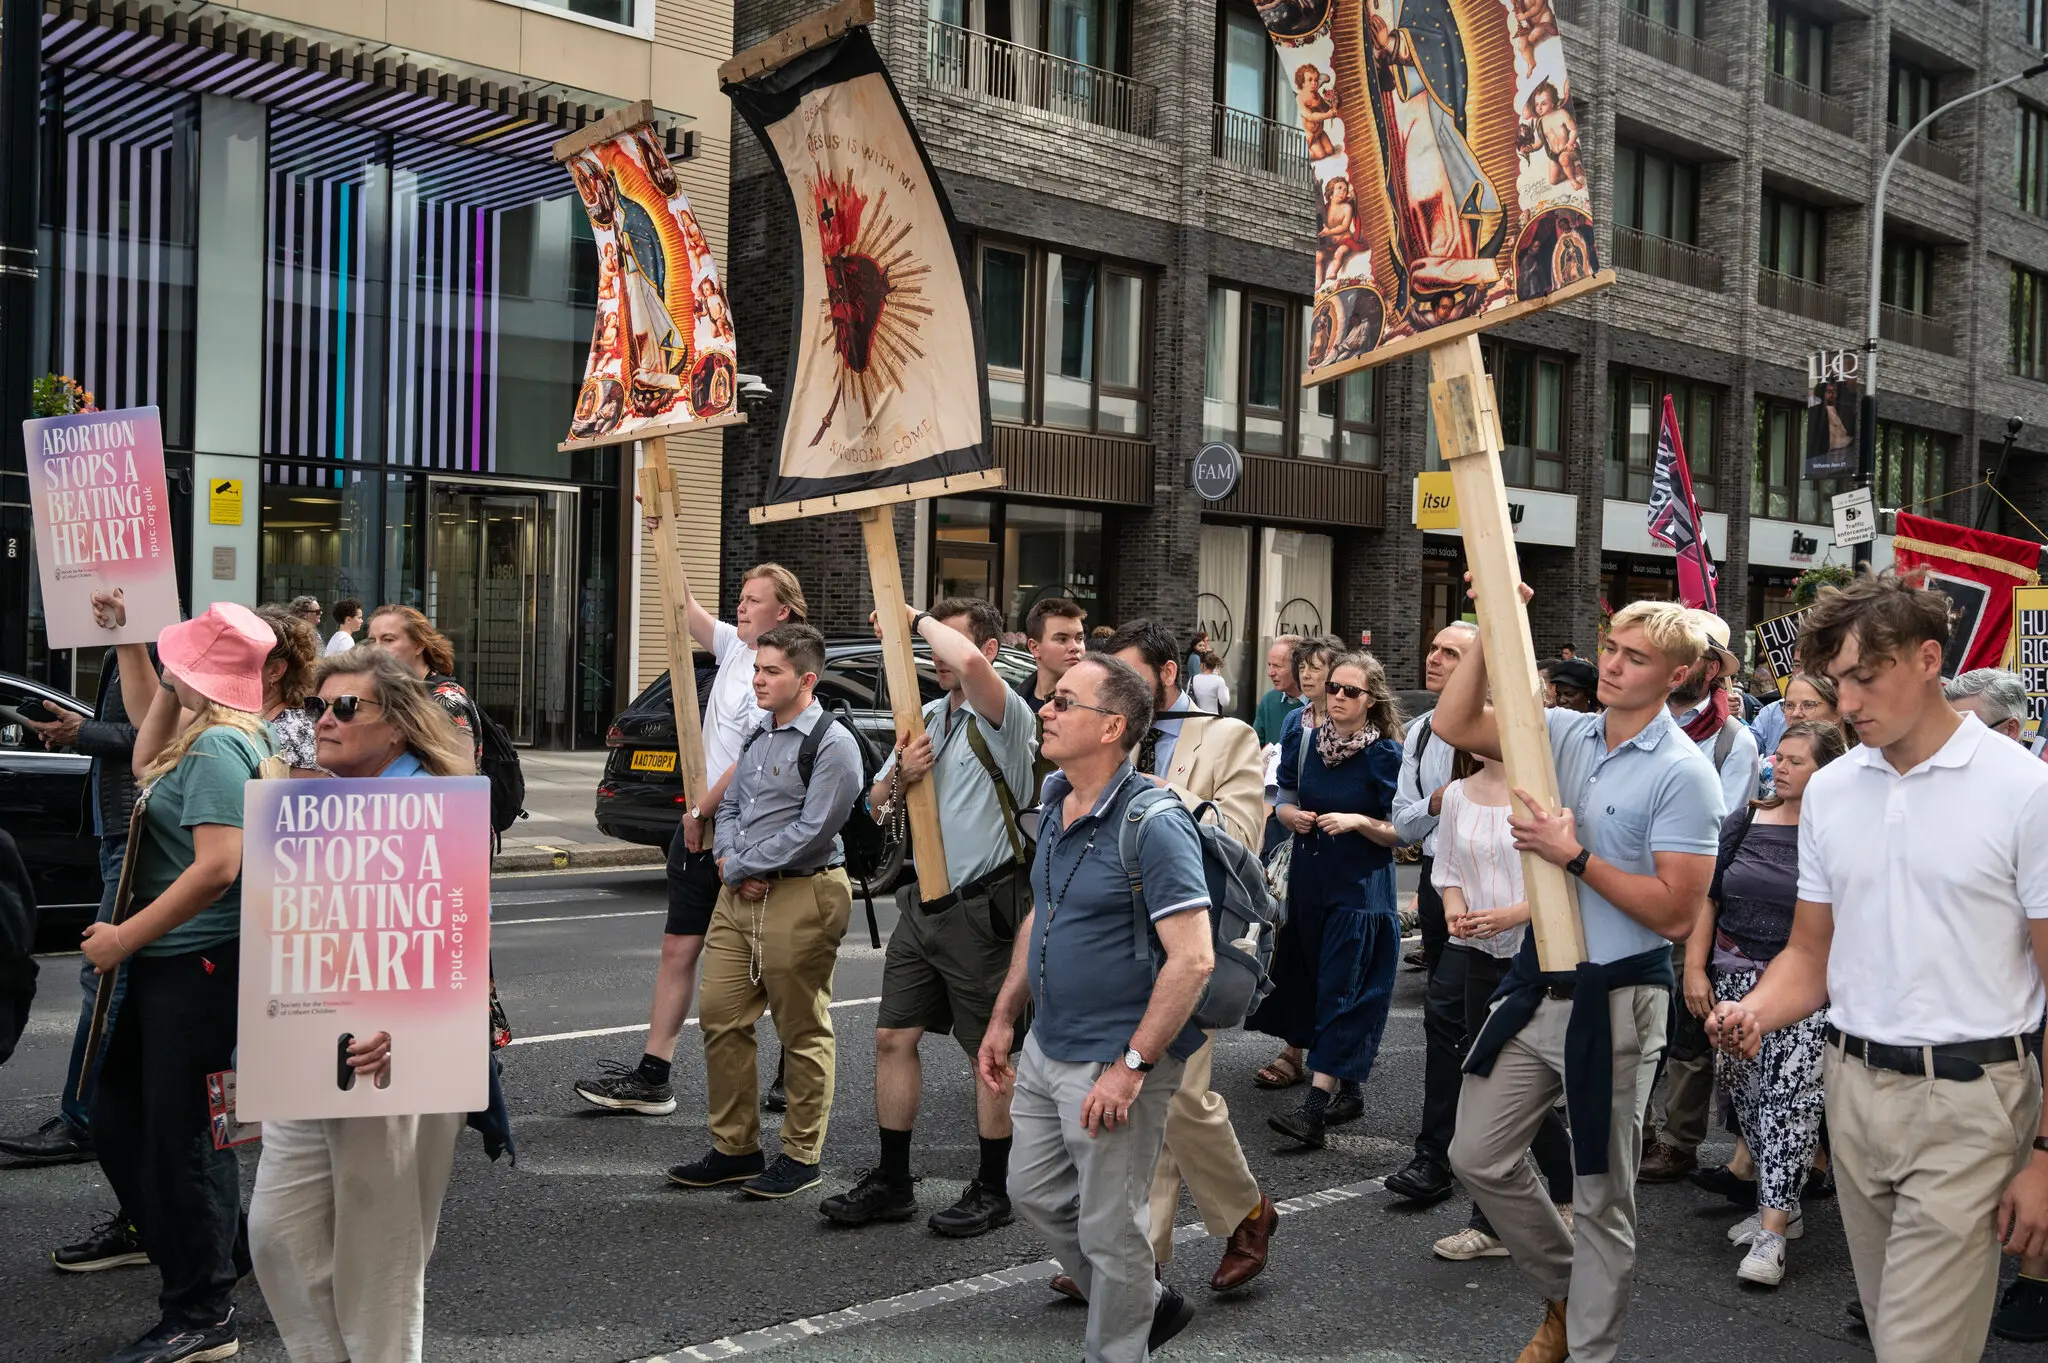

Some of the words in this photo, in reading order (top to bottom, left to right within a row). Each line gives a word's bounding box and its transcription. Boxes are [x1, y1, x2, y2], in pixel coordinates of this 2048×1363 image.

[847, 137, 857, 154] IS
[861, 144, 895, 175] WITH
[43, 420, 135, 456] ABORTION
[893, 418, 932, 455] COME
[44, 452, 117, 491] STOPS
[125, 450, 139, 483] A
[1198, 463, 1232, 480] FAM
[47, 484, 141, 524] BEATING
[1422, 492, 1451, 509] itsu
[143, 486, 159, 558] spuc.org.uk
[1837, 526, 1874, 538] enforcement
[1844, 533, 1869, 542] cameras
[1845, 522, 1865, 530] Traffic
[50, 516, 146, 566] HEART
[1438, 547, 1458, 557] salads
[1600, 562, 1618, 571] oodles
[2021, 611, 2048, 636] HU
[2021, 639, 2048, 664] RIG
[2021, 667, 2048, 693] BE
[2026, 696, 2046, 720] CO
[275, 793, 444, 833] ABORTION
[274, 834, 405, 884] STOPS
[418, 834, 443, 880] A
[270, 882, 443, 932] BEATING
[447, 887, 468, 990] spuc.org.uk
[269, 929, 445, 995] HEART
